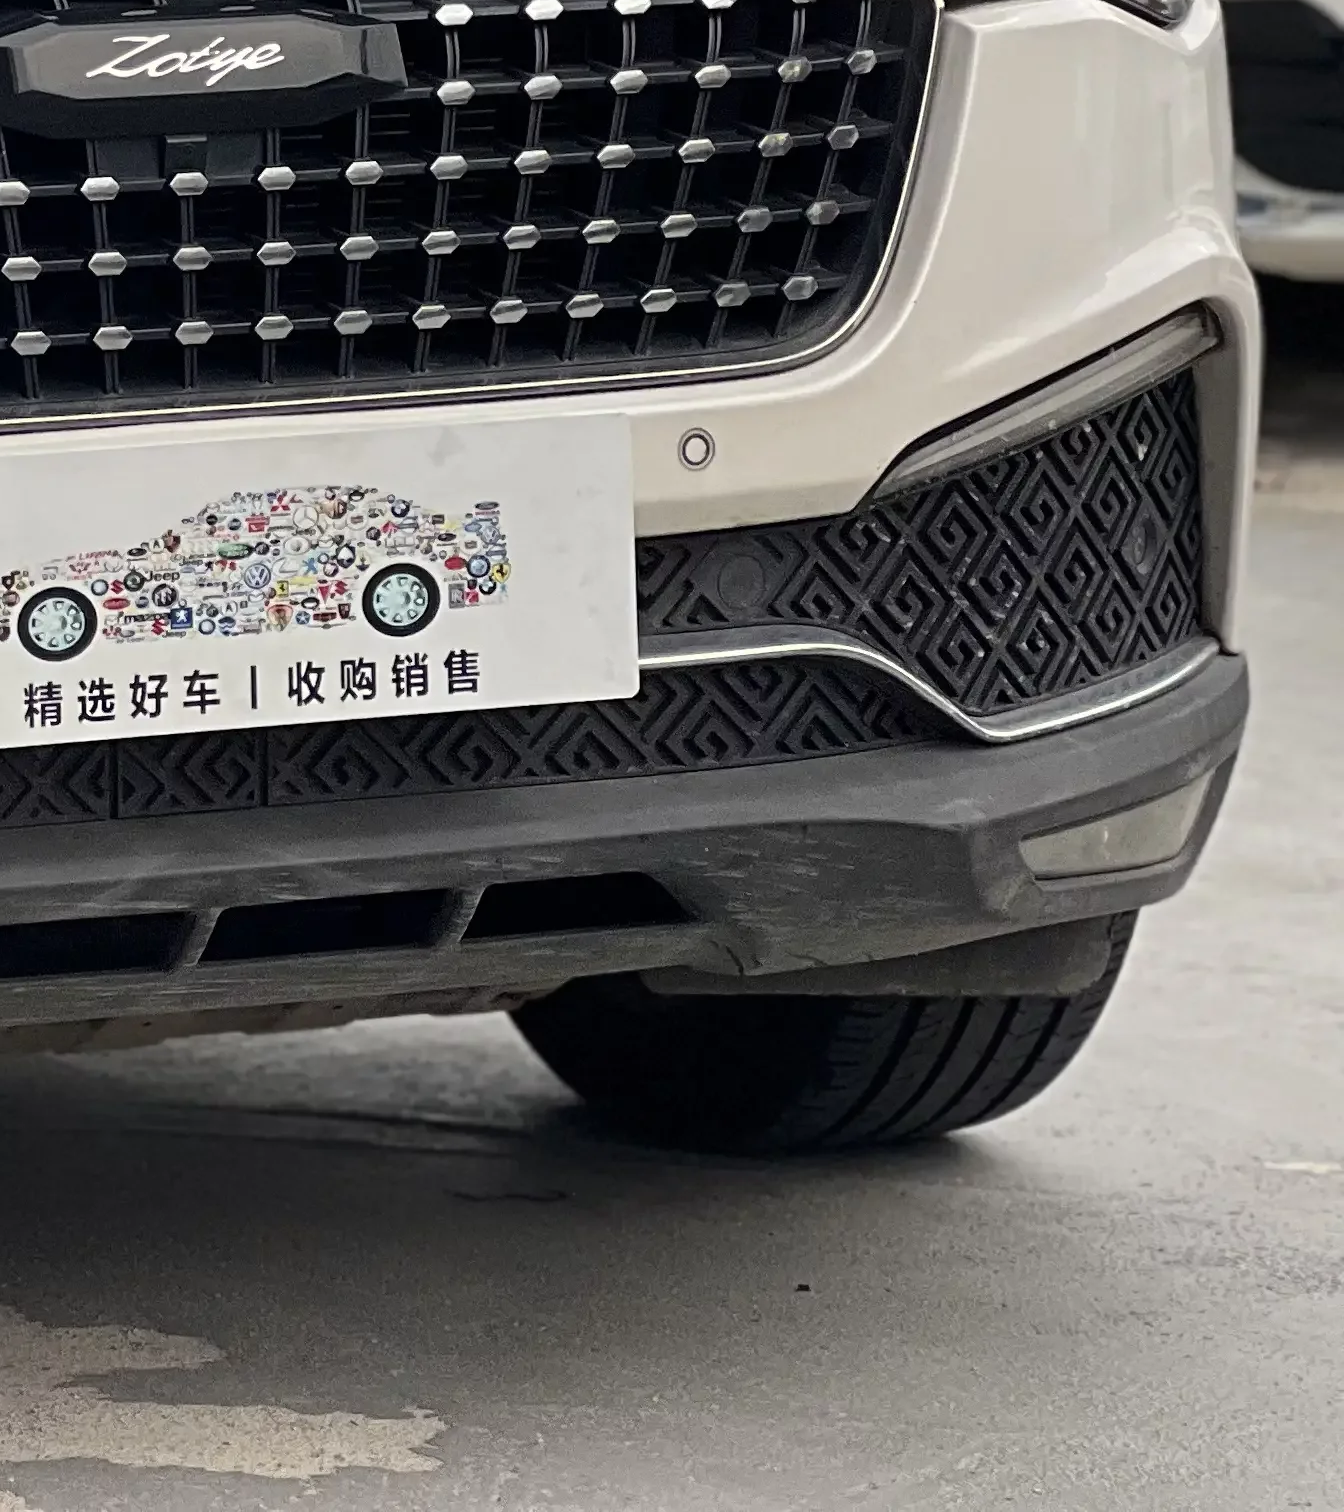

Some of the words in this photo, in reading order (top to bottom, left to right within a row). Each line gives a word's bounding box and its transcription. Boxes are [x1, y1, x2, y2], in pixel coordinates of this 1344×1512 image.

[86, 34, 285, 87] Zotye
[145, 570, 181, 583] Jeep
[23, 668, 221, 729] 精选好车
[287, 649, 481, 707] 收购销售
